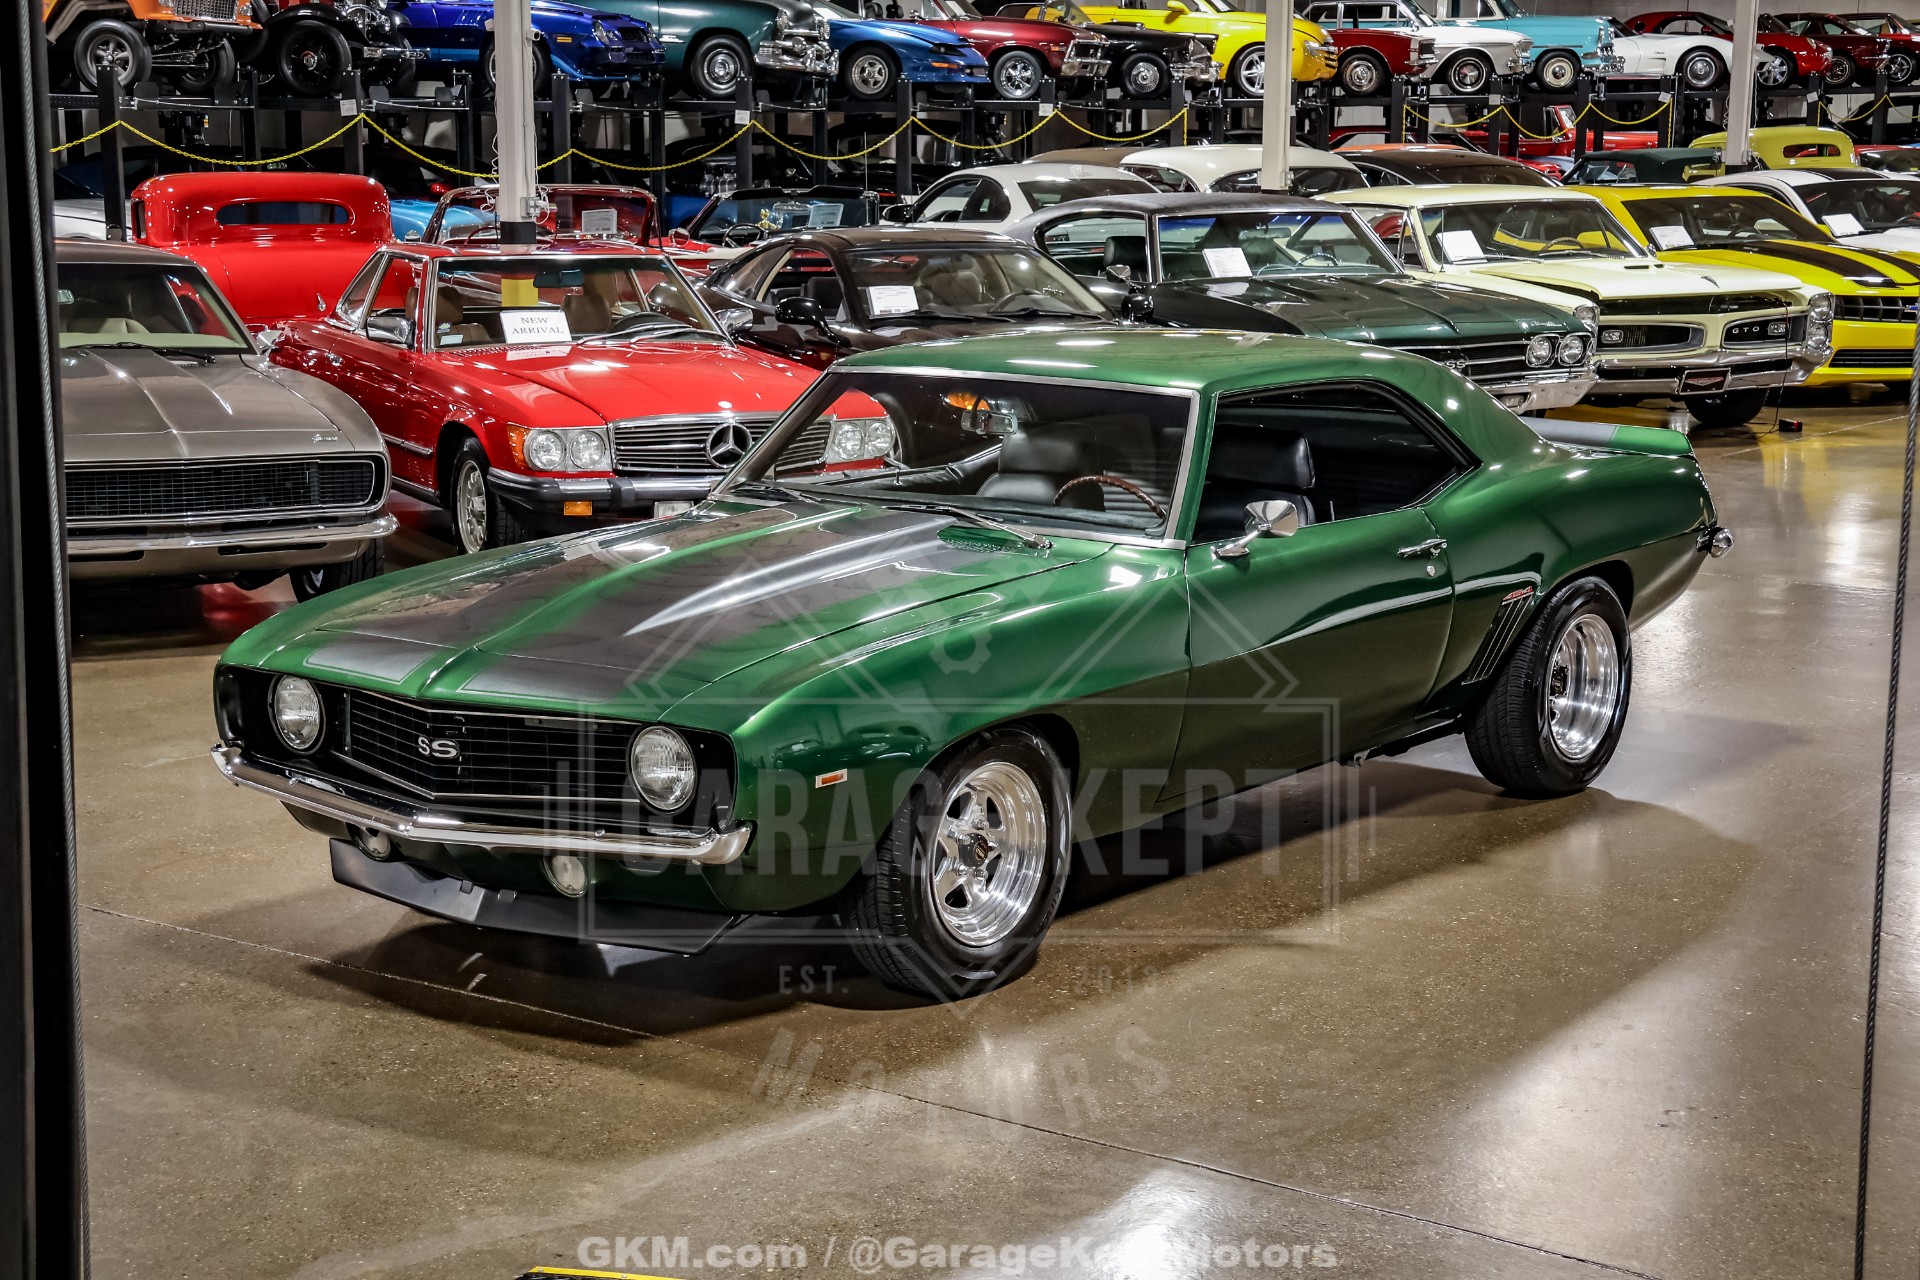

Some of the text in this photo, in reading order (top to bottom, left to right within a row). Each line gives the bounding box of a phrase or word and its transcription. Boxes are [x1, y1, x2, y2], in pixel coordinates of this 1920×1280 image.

[511, 326, 564, 335] ARRIVAL
[1732, 326, 1760, 334] GTO
[1445, 360, 1466, 369] SS
[417, 736, 458, 758] SS
